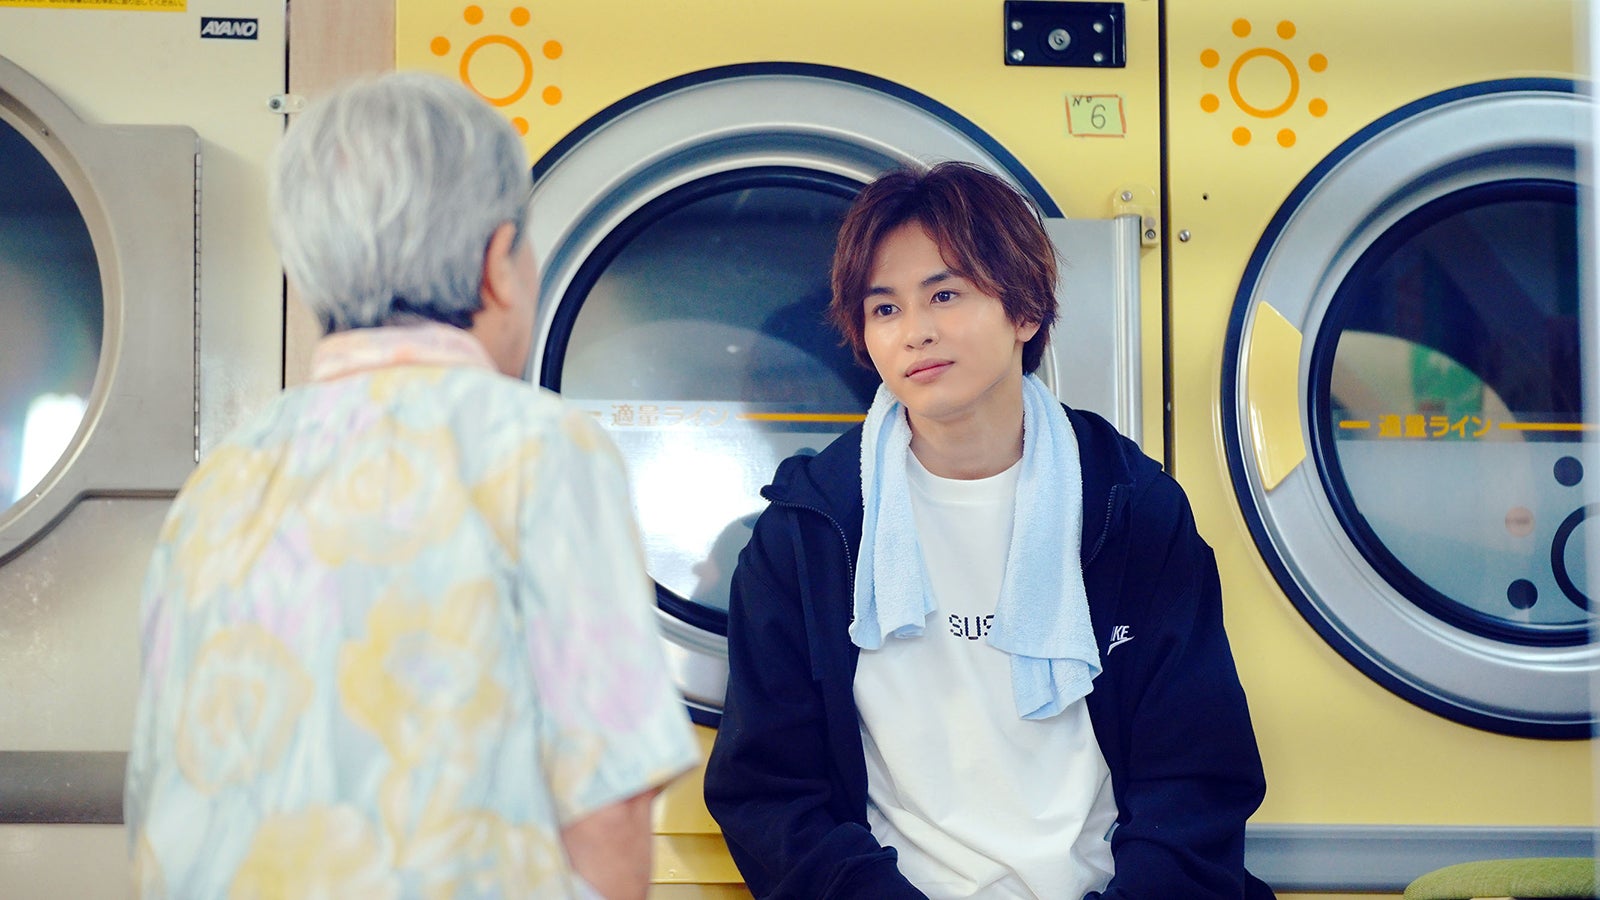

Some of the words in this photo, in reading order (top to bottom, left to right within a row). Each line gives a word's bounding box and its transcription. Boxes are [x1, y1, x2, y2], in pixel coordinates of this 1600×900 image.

[202, 21, 257, 37] AYANO
[1091, 104, 1106, 129] 6
[611, 403, 729, 426] 適量ライン
[1378, 414, 1491, 438] 適量ライン
